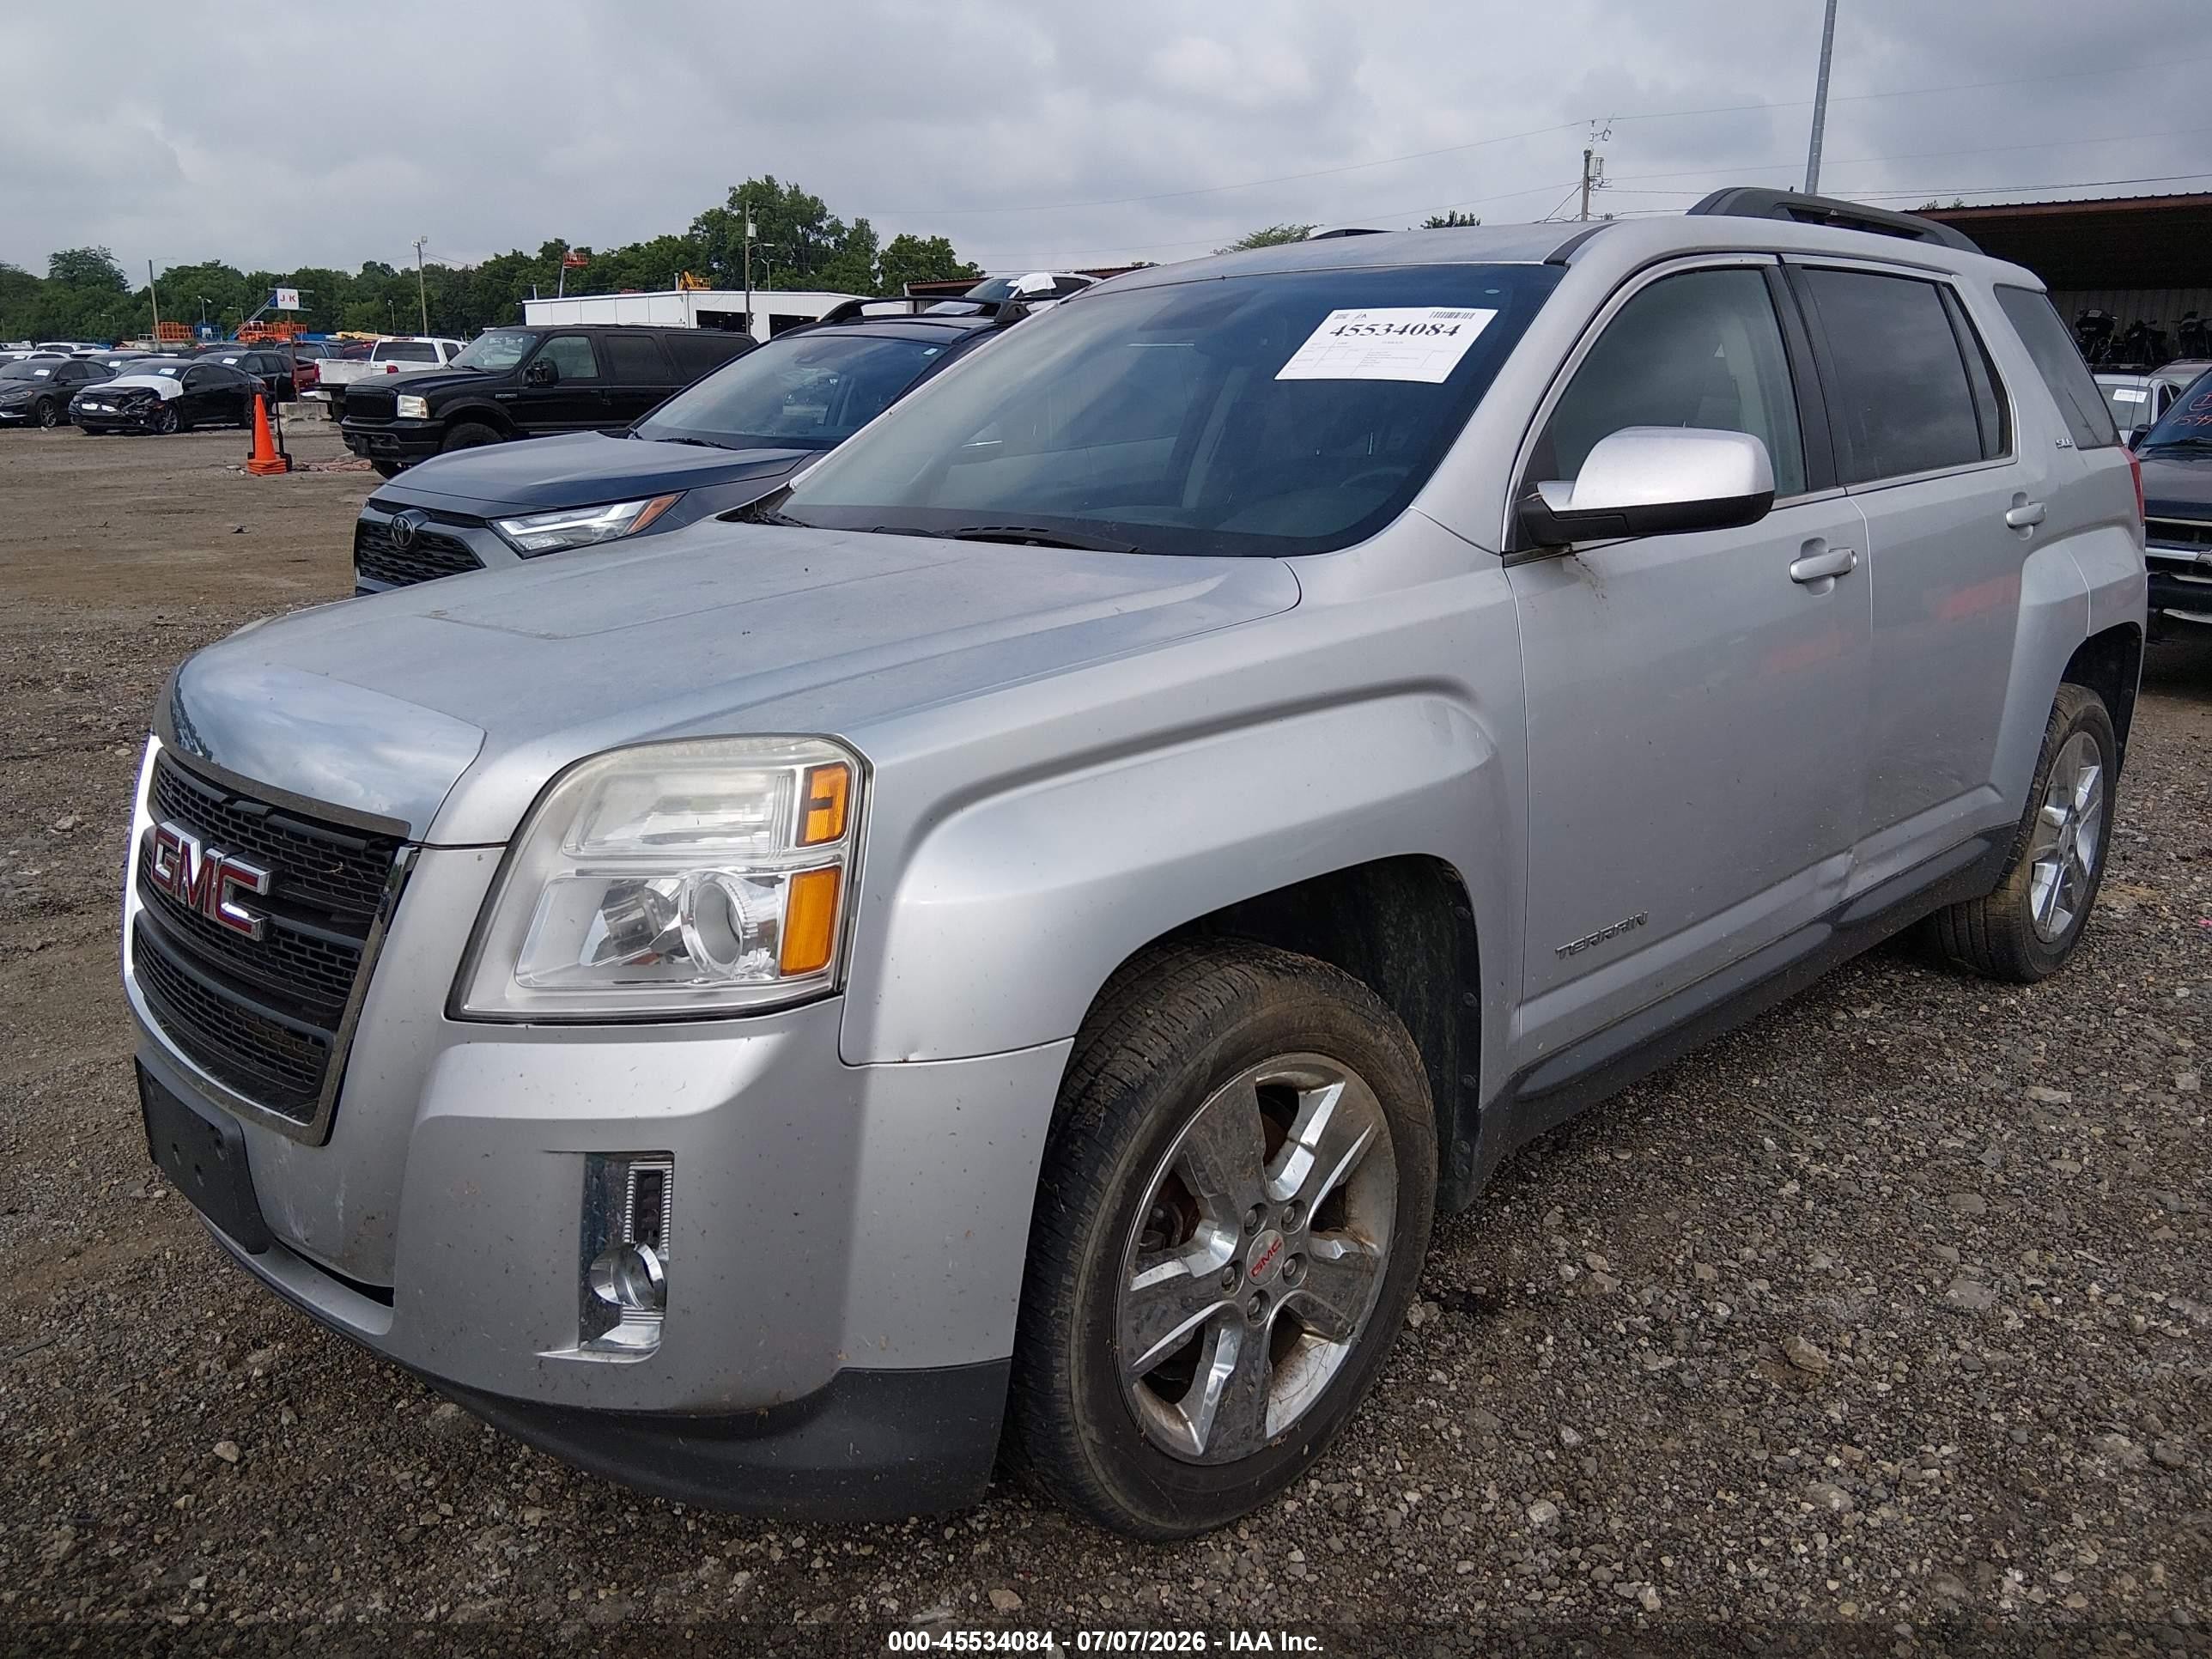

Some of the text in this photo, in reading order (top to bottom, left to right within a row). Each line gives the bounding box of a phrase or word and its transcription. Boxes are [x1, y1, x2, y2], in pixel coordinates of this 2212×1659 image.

[1329, 322, 1462, 337] 45534084
[150, 821, 270, 942] GMC
[1554, 911, 1649, 959] TERRAIN
[1250, 1237, 1283, 1278] GMC
